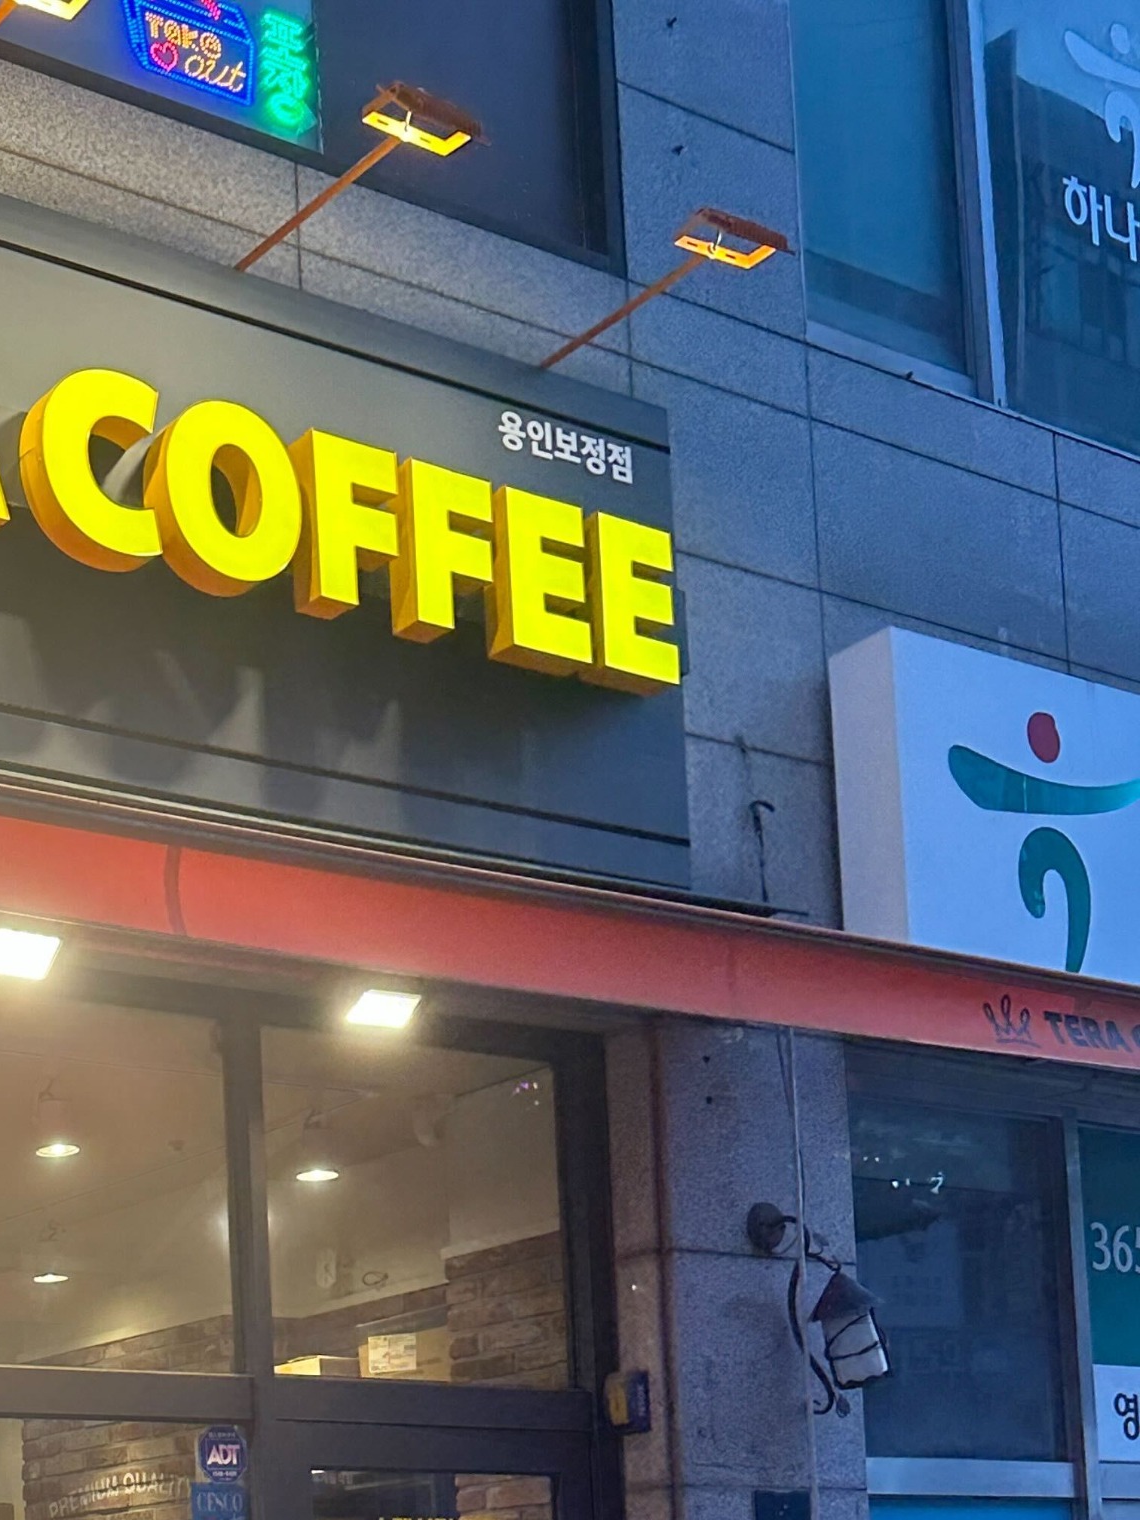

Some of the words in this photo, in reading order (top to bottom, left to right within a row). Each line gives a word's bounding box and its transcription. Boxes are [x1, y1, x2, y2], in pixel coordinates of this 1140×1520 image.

[144, 11, 221, 59] Take
[184, 55, 247, 93] out
[498, 411, 634, 484] 용인보정점
[19, 369, 684, 697] COFFEE
[1044, 1010, 1133, 1053] TERA
[207, 1444, 241, 1466] ADT
[197, 1491, 243, 1512] CESCO
